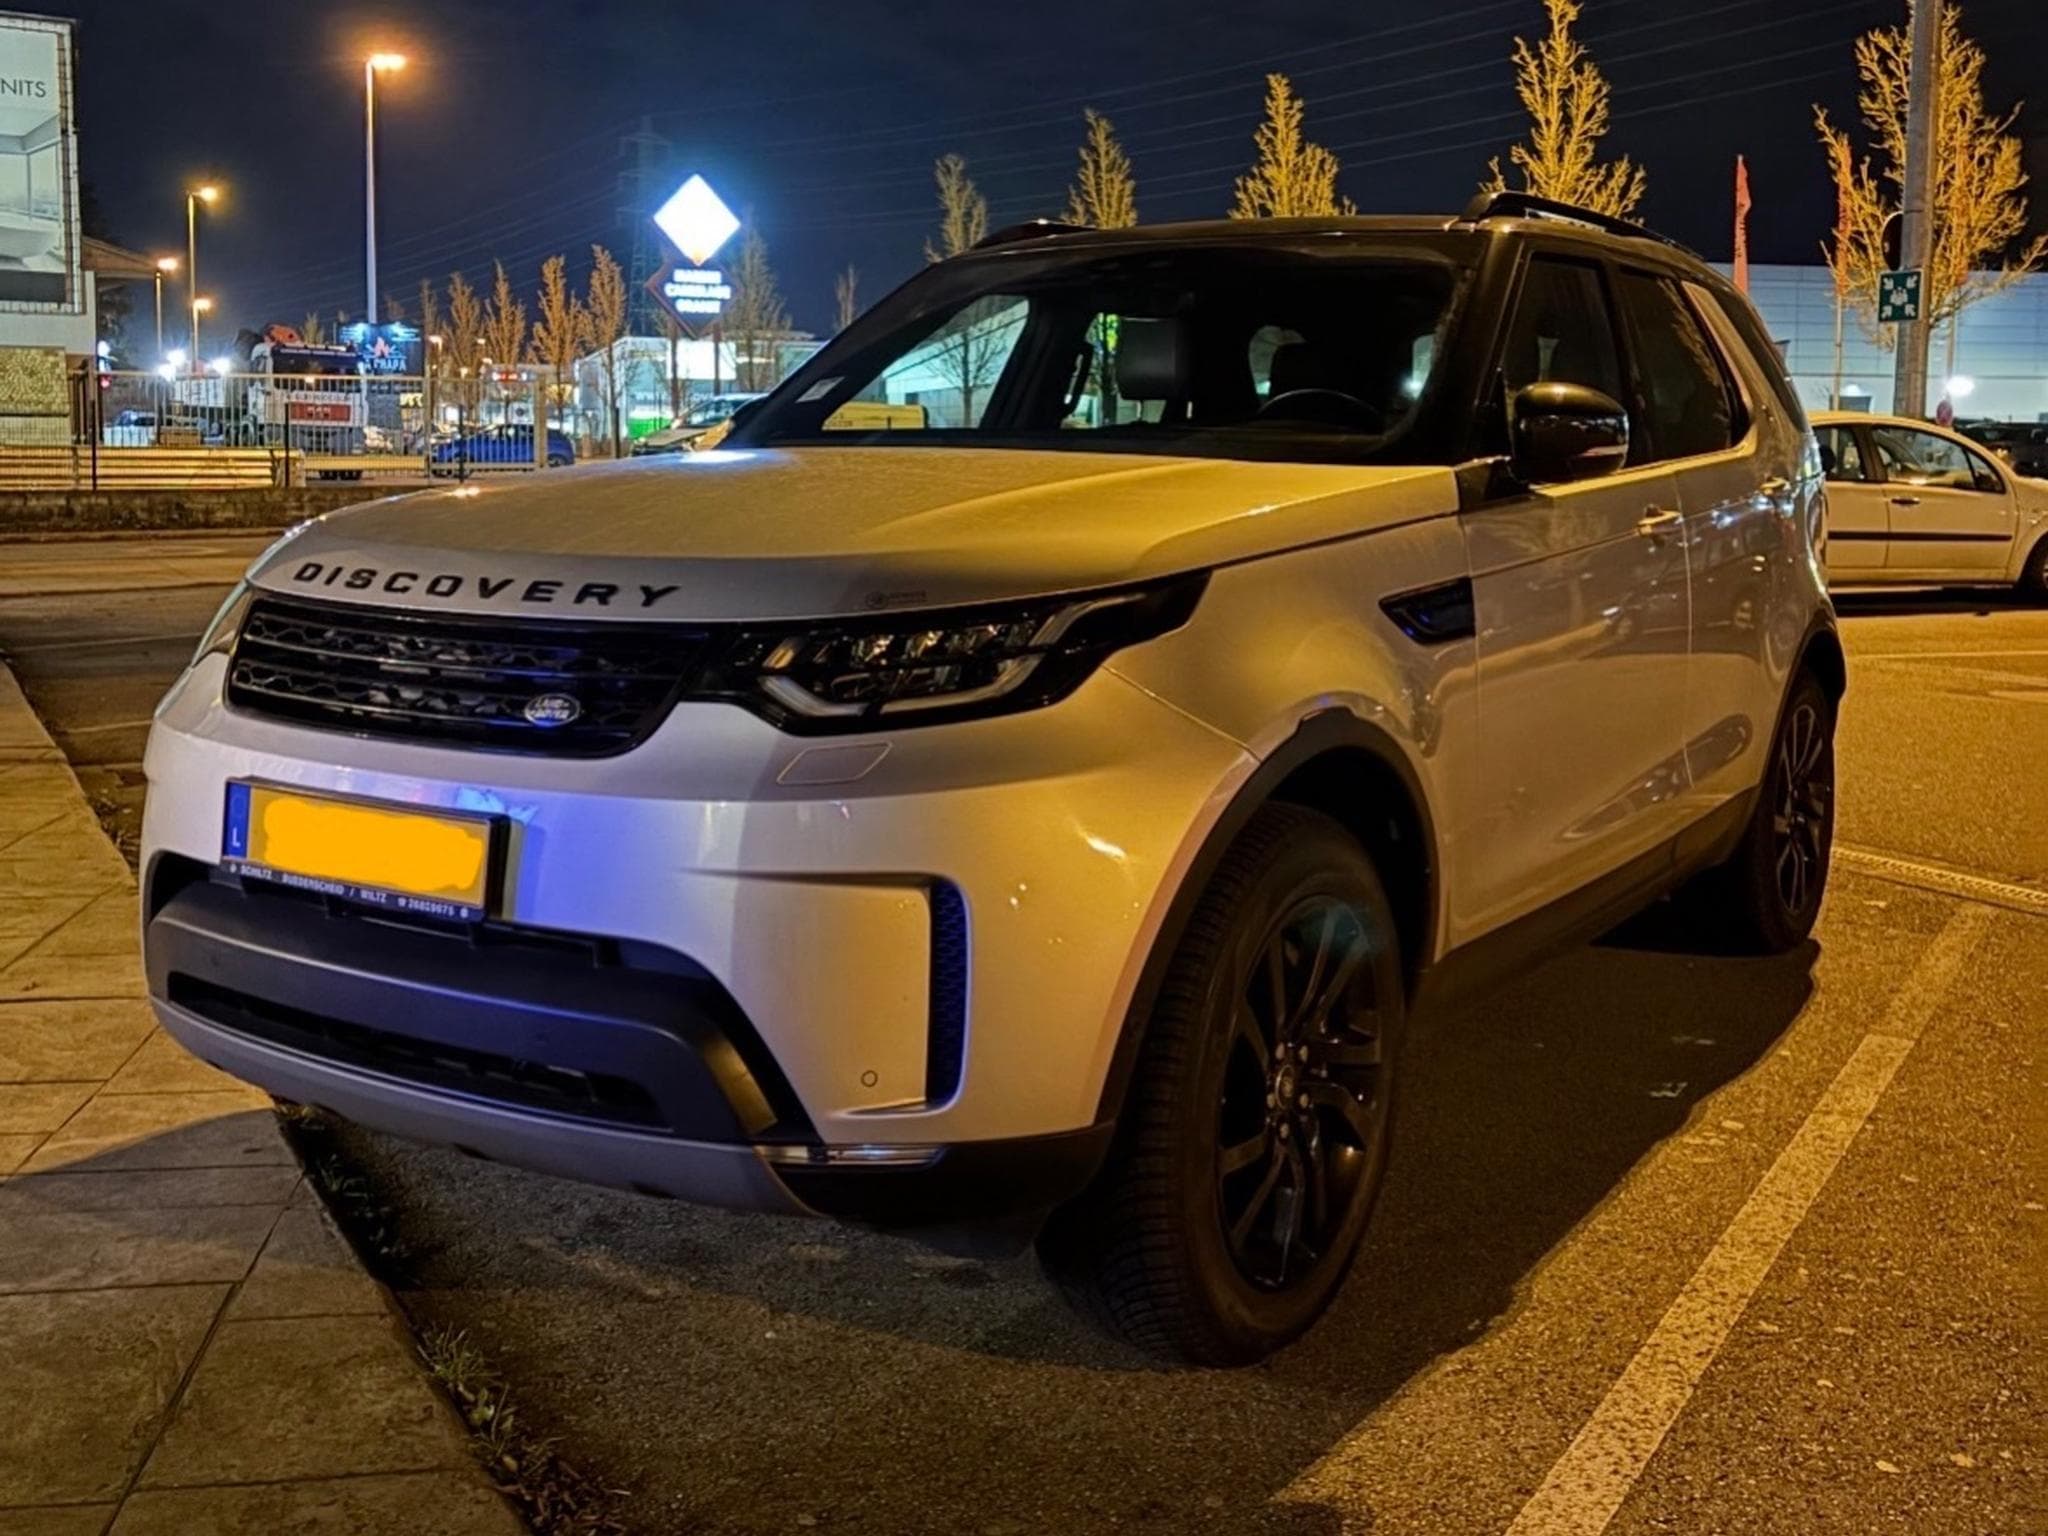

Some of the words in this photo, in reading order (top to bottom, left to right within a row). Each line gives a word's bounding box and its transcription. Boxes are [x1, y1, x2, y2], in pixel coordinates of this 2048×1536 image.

[293, 562, 683, 608] DISCOVERY
[231, 827, 241, 848] L
[360, 889, 387, 904] WILTZ
